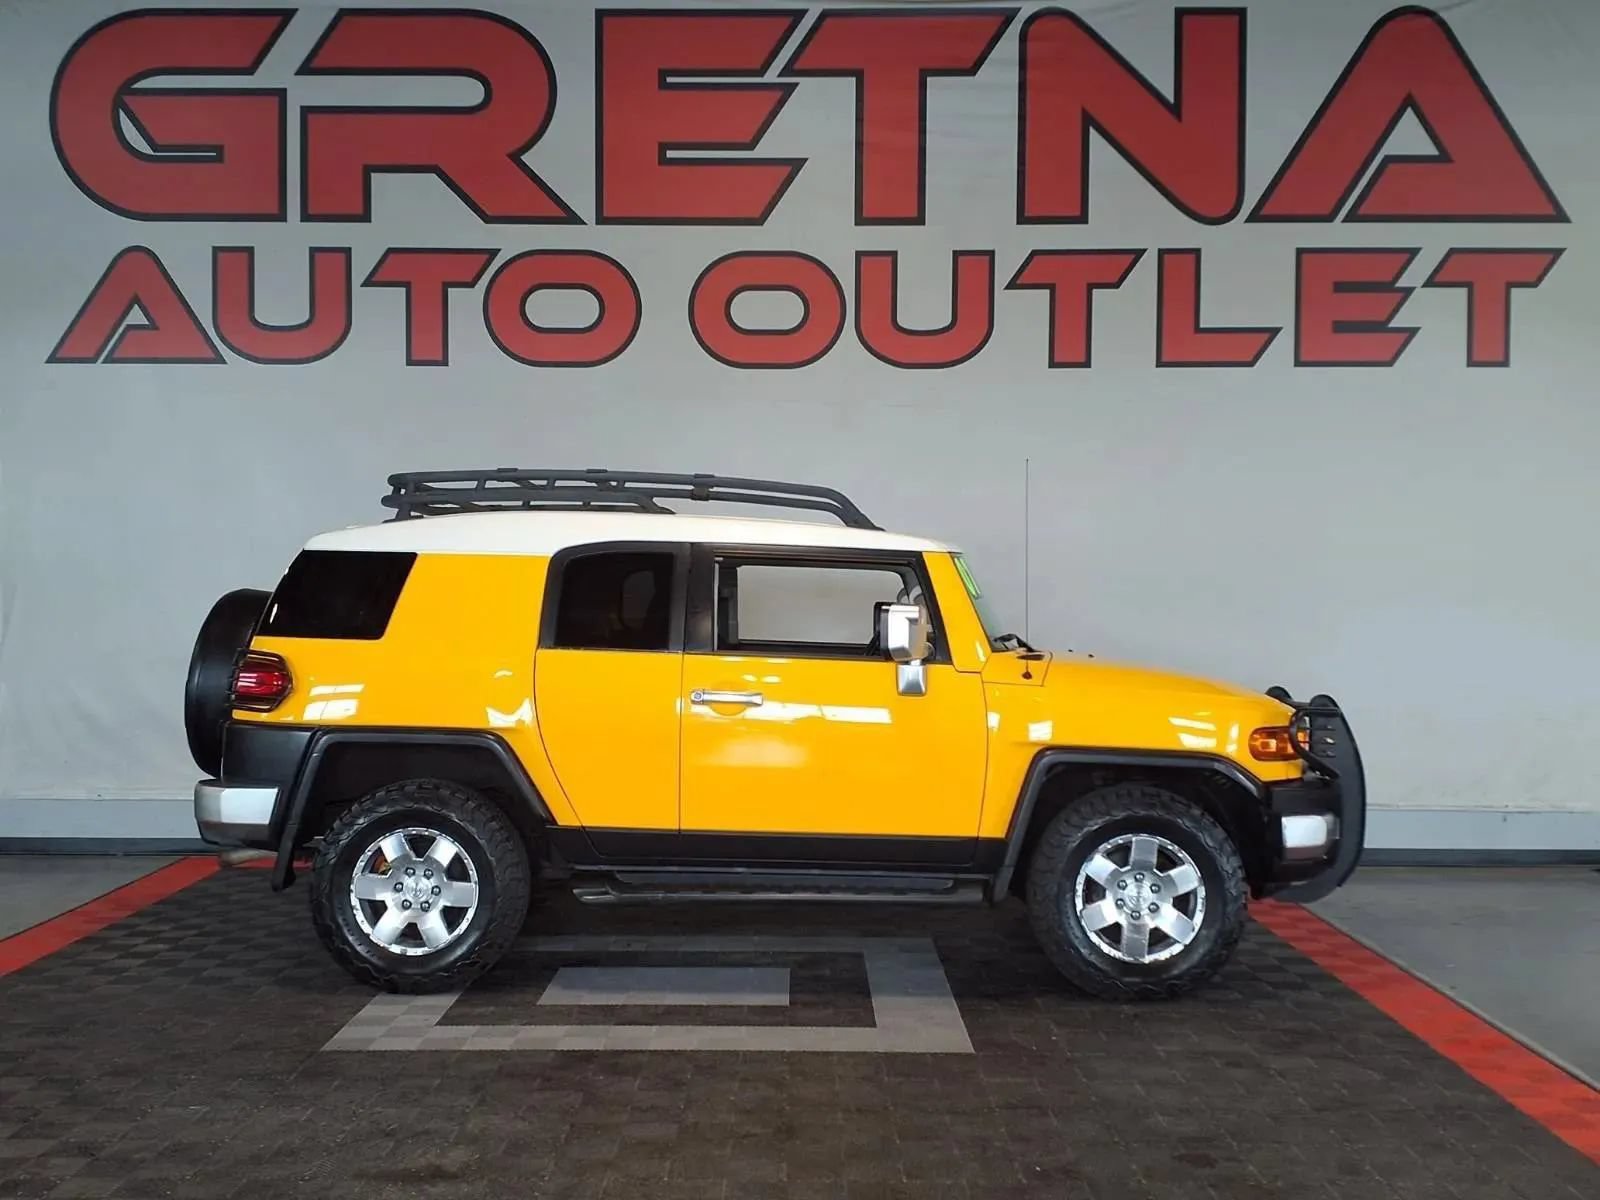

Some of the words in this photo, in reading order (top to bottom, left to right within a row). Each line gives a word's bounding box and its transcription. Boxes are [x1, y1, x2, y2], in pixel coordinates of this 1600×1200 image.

[49, 5, 1571, 225] GRETNA
[45, 245, 642, 367] AUTO
[688, 247, 1567, 369] OUTLET
